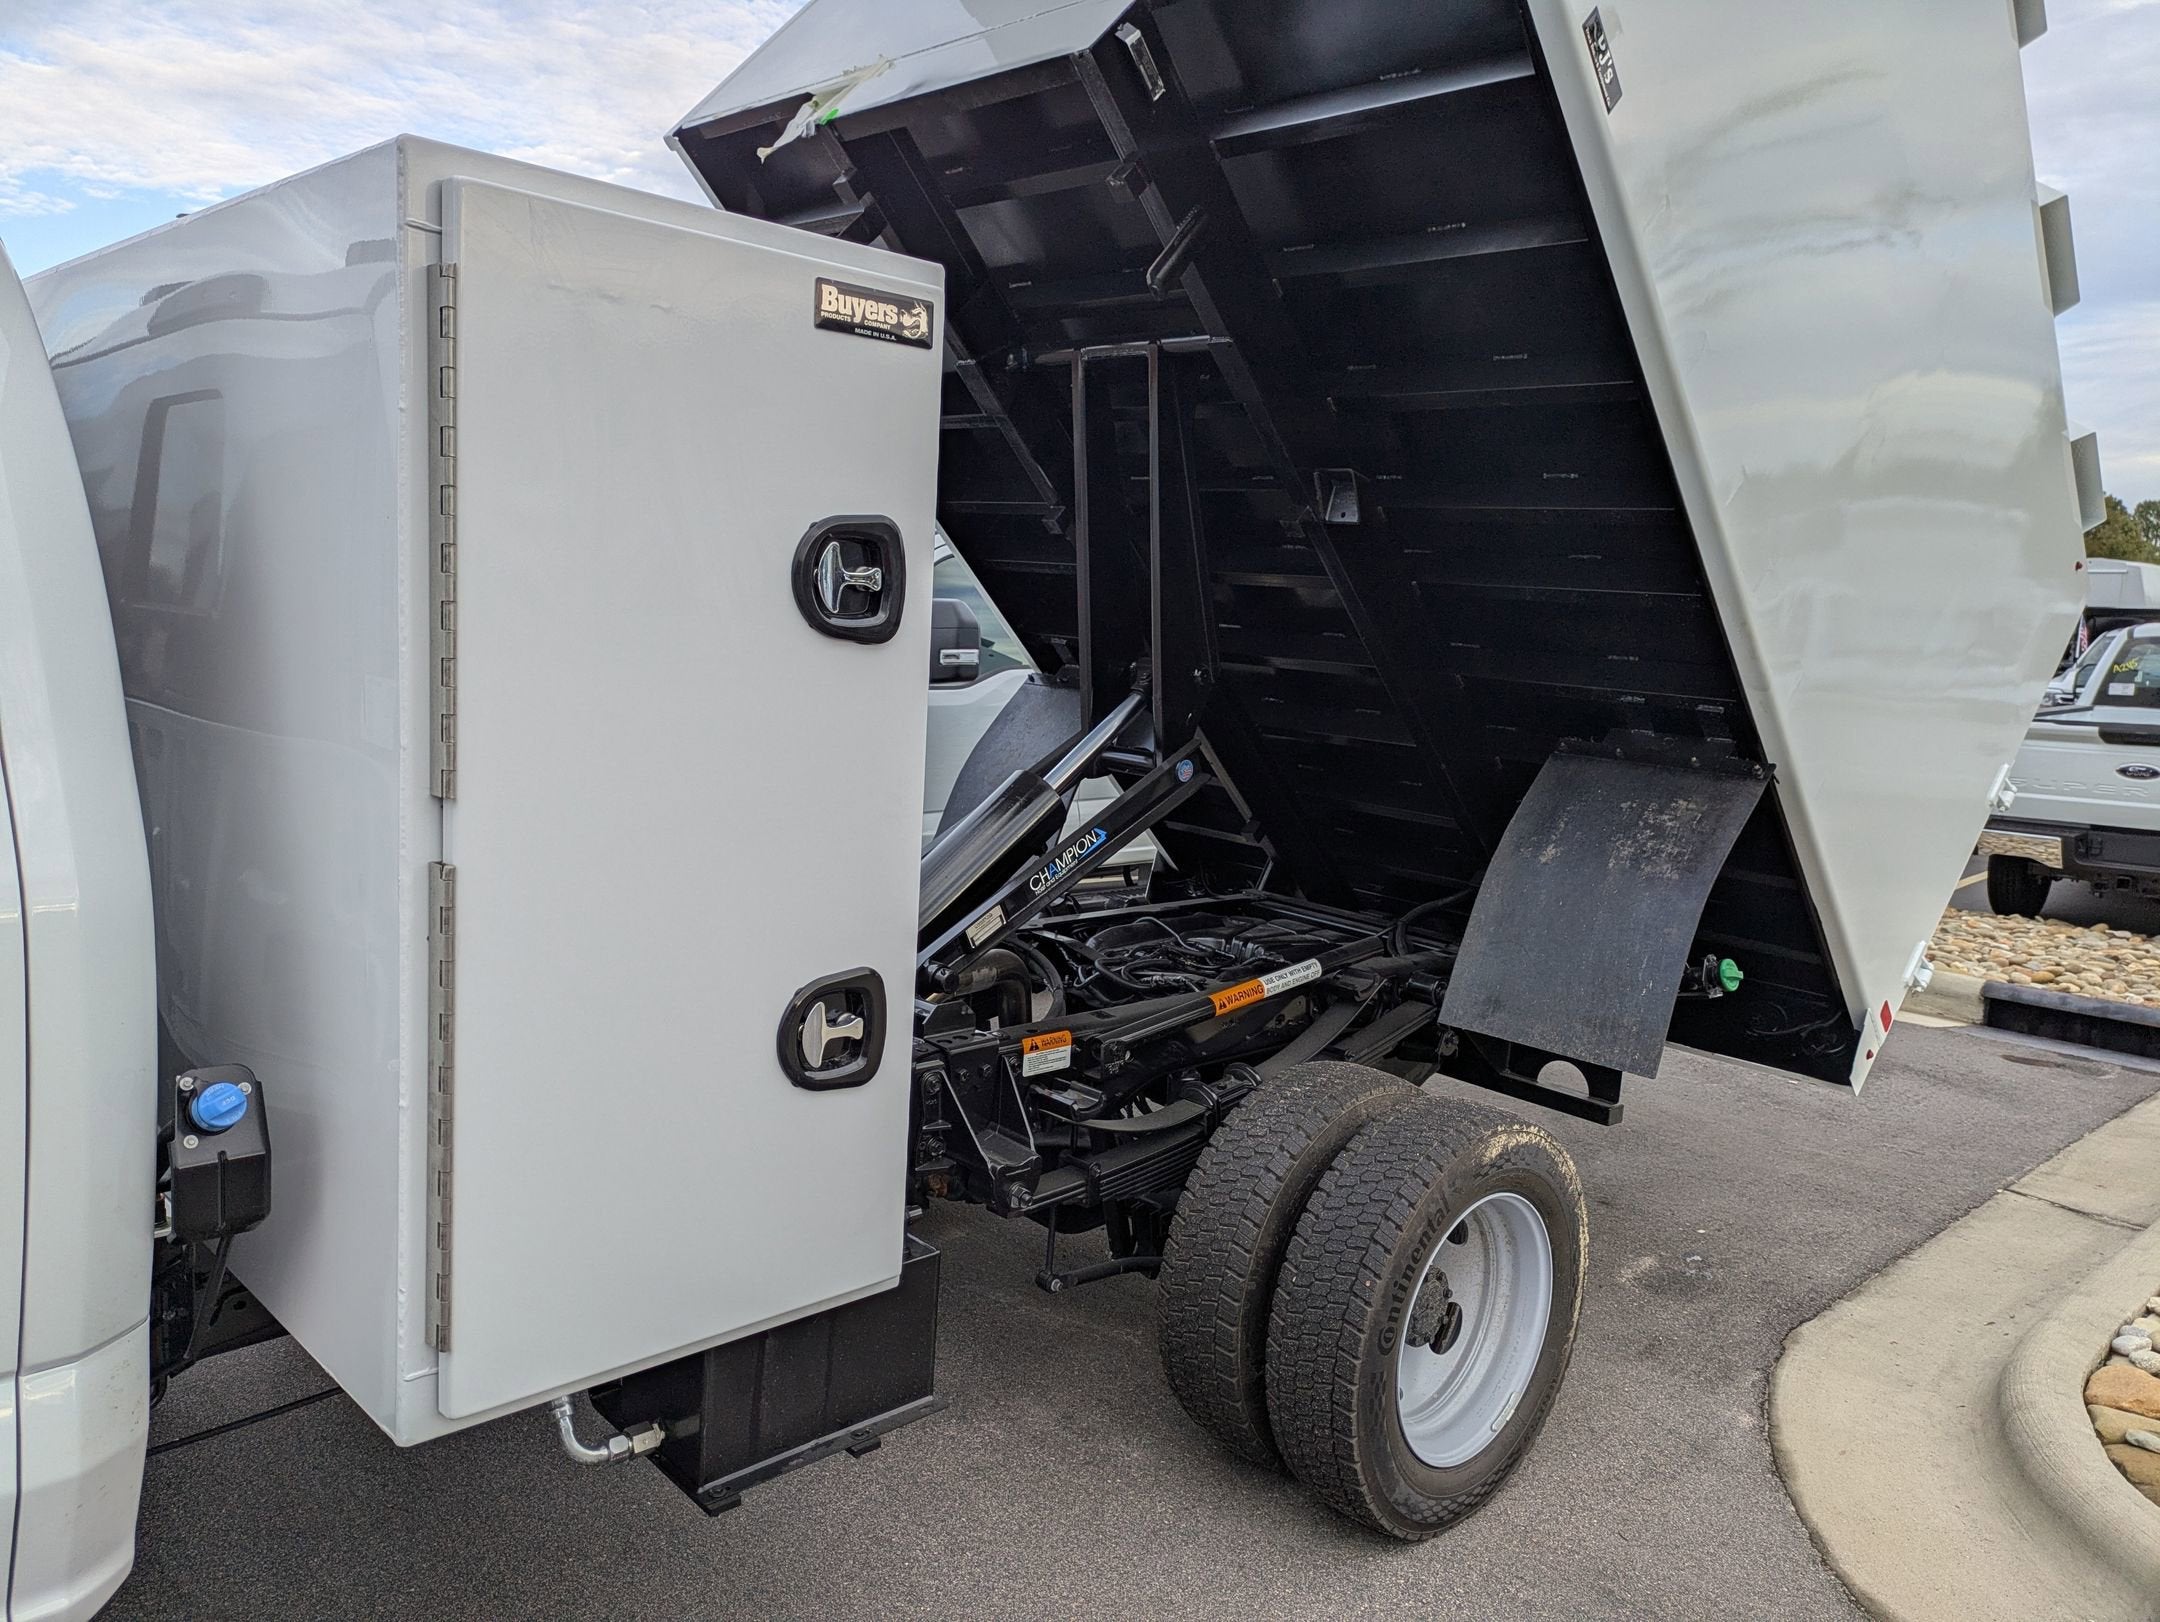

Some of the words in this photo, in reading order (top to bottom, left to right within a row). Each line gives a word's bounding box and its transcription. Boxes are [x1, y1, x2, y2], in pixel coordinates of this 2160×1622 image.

[821, 284, 898, 324] Buyers
[821, 311, 851, 322] PRODUCTS
[864, 320, 891, 330] COMPANY
[854, 328, 872, 336] MADE
[1030, 830, 1096, 891] CHAMPION
[1264, 977, 1276, 986] USE
[1276, 972, 1288, 982] ONLY
[1289, 968, 1301, 978] WITH
[1302, 962, 1318, 973] EMPTY
[1226, 984, 1264, 1005] WARNING
[1378, 1190, 1451, 1356] Continental
